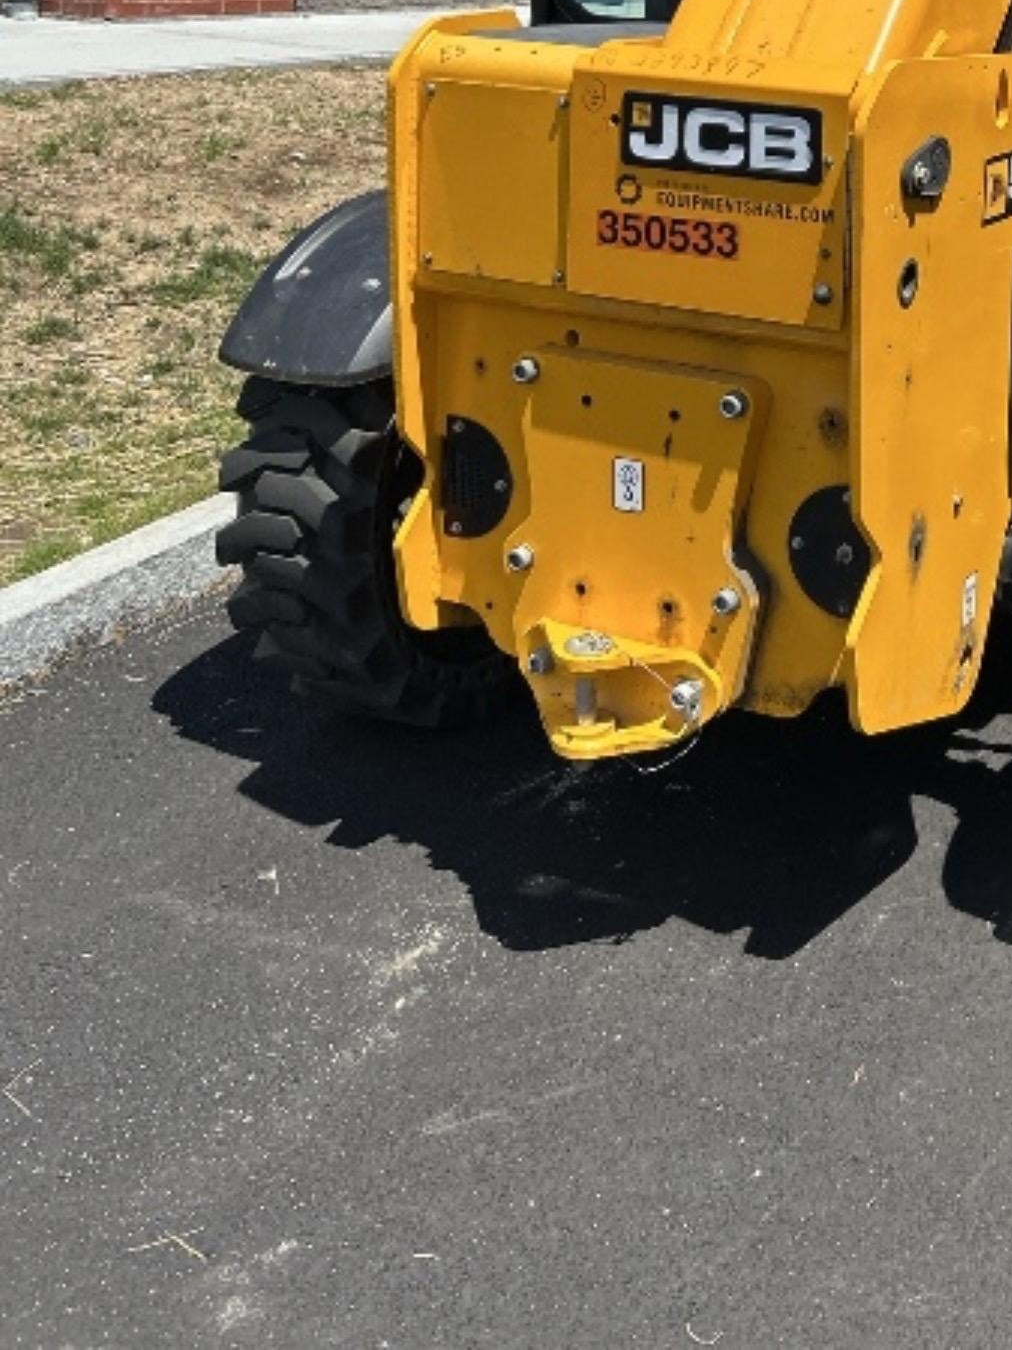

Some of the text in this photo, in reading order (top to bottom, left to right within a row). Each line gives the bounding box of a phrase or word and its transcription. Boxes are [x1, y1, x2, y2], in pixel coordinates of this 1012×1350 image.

[629, 104, 814, 172] JCB
[655, 191, 835, 224] EQUIPMENTSHARE.COM
[598, 209, 740, 259] 350533
